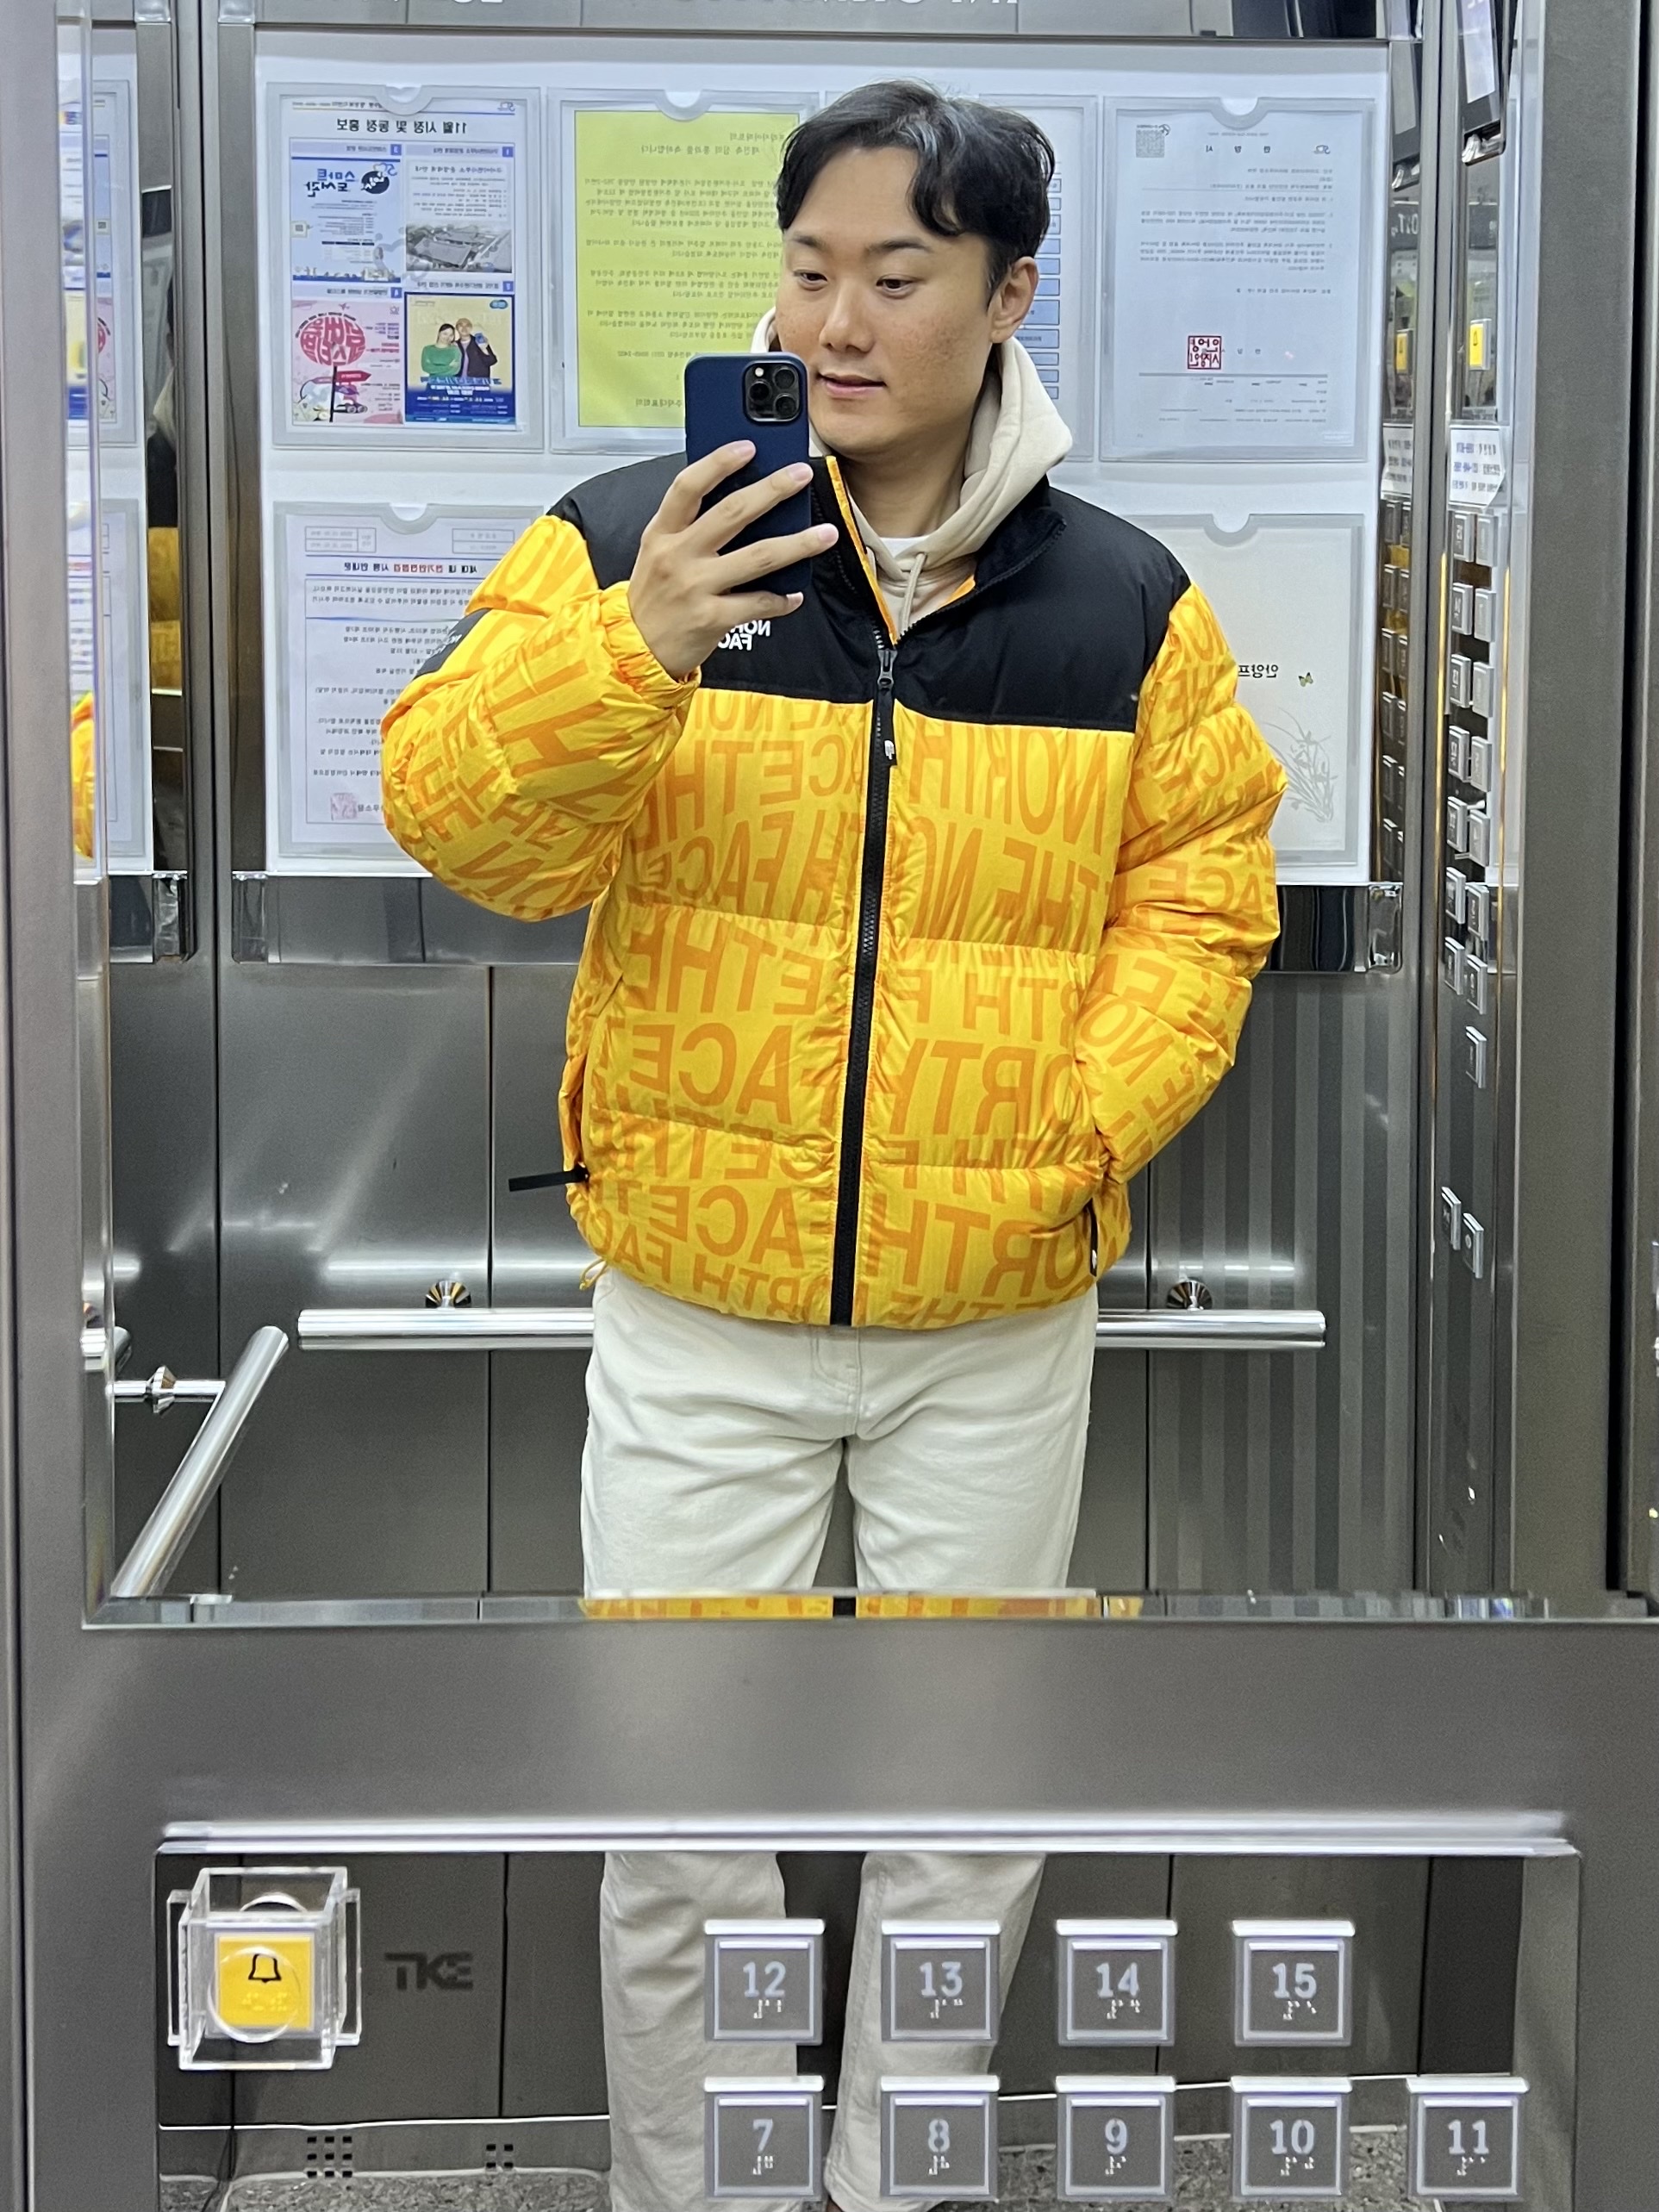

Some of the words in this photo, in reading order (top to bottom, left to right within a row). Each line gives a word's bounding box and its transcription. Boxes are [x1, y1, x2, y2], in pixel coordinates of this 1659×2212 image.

[384, 1951, 474, 1991] TKE
[743, 1961, 786, 1997] 12
[920, 1961, 964, 1997] 13
[1095, 1961, 1140, 1997] 14
[1272, 1962, 1317, 1998] 15
[752, 2118, 775, 2153] 7
[926, 2118, 951, 2153] 8
[1104, 2118, 1128, 2153] 9
[1269, 2118, 1317, 2154] 10
[1448, 2119, 1490, 2154] 11
